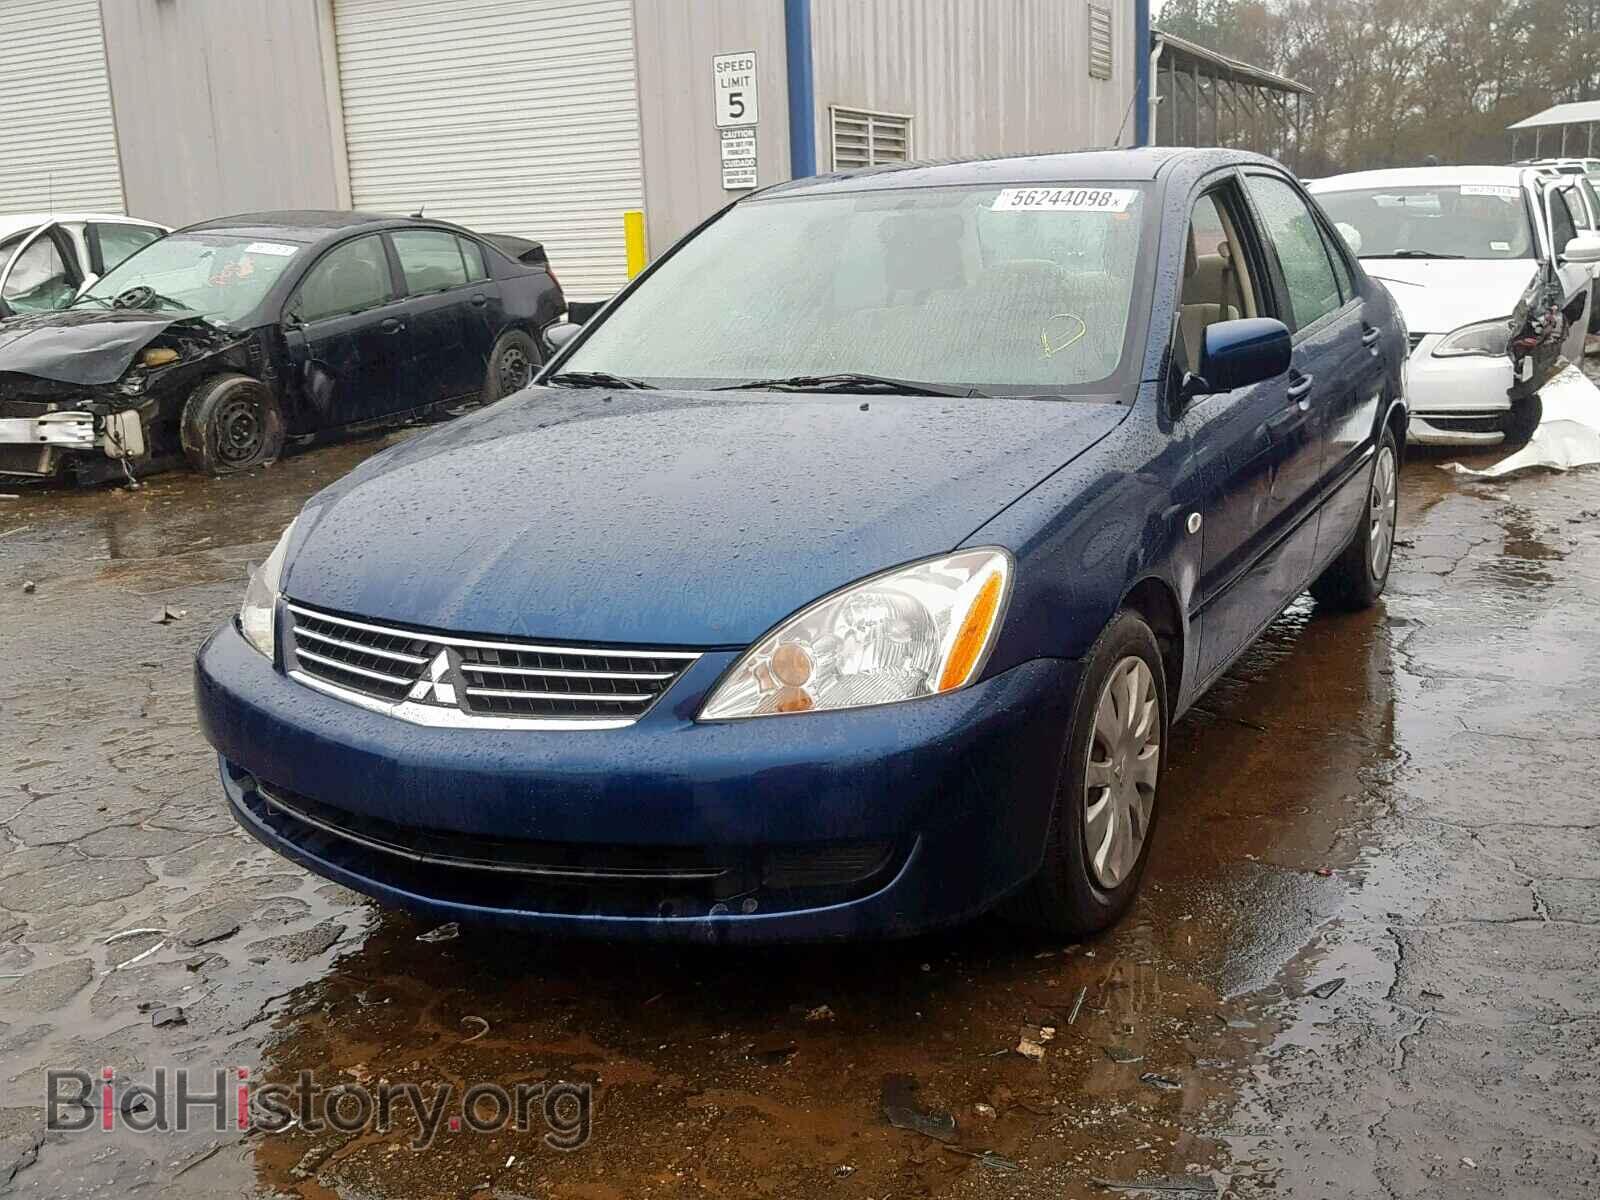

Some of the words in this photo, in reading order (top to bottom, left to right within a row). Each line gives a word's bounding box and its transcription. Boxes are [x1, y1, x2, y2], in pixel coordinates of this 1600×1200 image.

[716, 60, 753, 73] SPEED
[721, 76, 751, 88] LIMIT
[729, 92, 745, 118] 5
[723, 130, 755, 140] CAUTION
[724, 159, 756, 168] CUIDADO
[1010, 190, 1113, 207] 56244098
